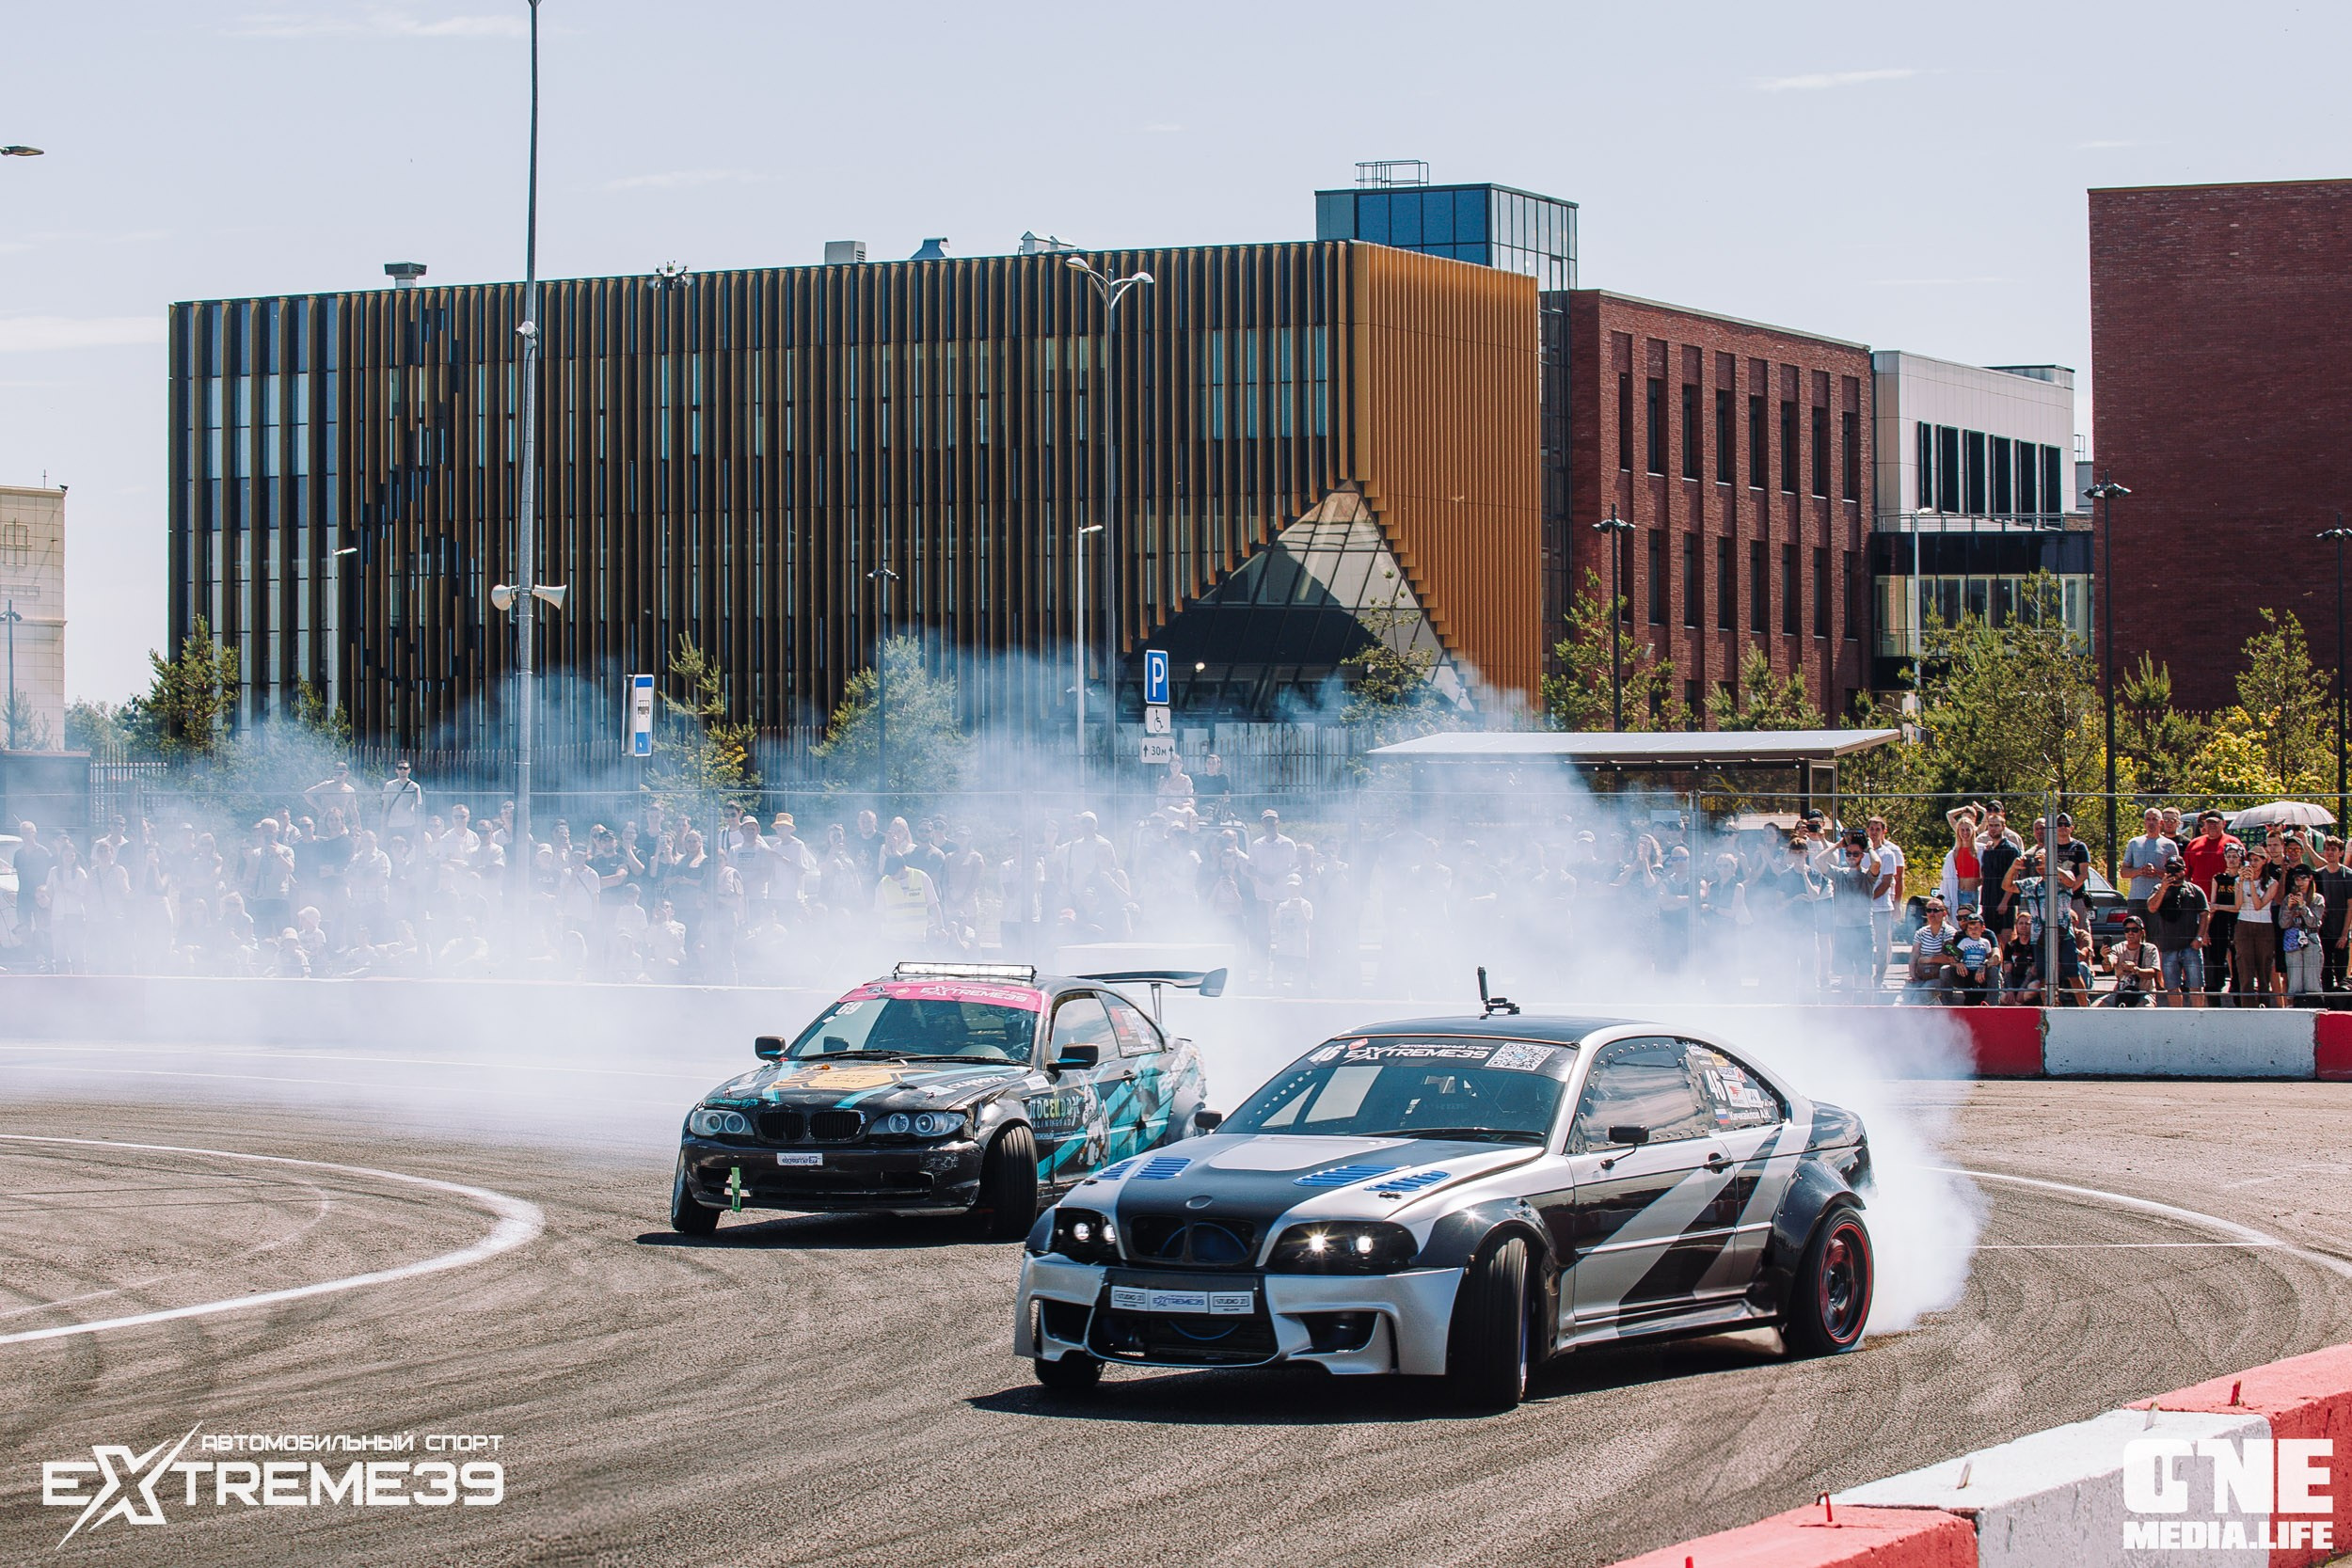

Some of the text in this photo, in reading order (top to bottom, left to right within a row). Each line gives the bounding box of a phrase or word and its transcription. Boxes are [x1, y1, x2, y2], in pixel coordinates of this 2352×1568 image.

[1152, 657, 1165, 698] P
[919, 985, 1028, 1003] EXTREME39
[835, 1001, 863, 1015] 69
[1309, 1045, 1345, 1062] 46
[1341, 1042, 1489, 1064] EXTREME39
[1705, 1069, 1727, 1101] 46
